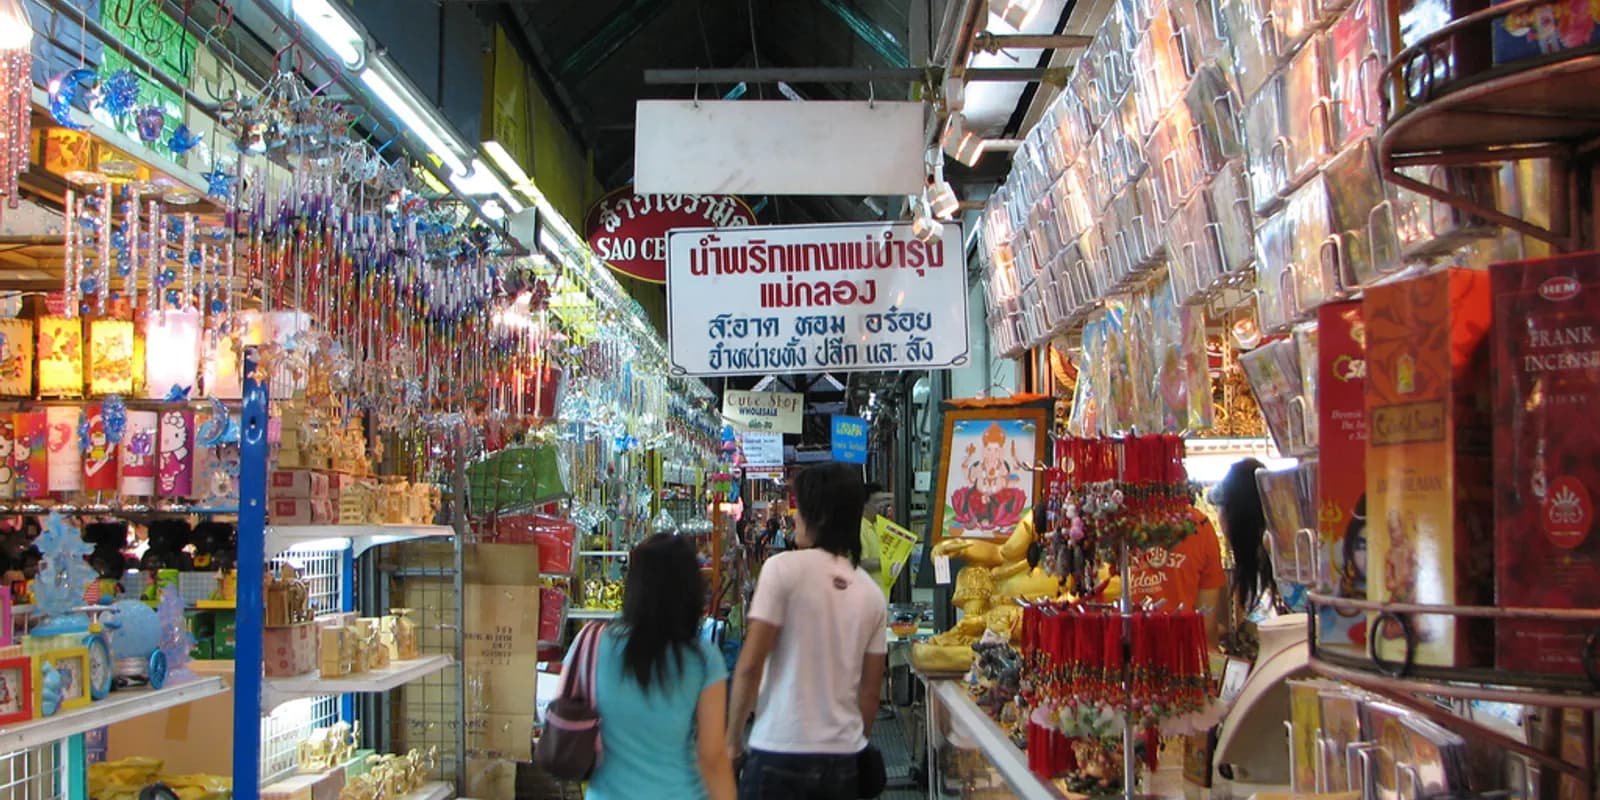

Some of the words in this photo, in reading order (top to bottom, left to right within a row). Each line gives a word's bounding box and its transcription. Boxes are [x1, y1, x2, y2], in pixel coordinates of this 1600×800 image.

[597, 237, 636, 260] SAO
[641, 237, 665, 260] CE
[761, 275, 876, 307] แม่กลอง
[709, 313, 779, 339] สะอาด
[795, 315, 845, 337] หอม
[1529, 326, 1593, 347] FRANK
[709, 336, 806, 369] จำหน่ายทั้ง
[866, 343, 897, 364] และ
